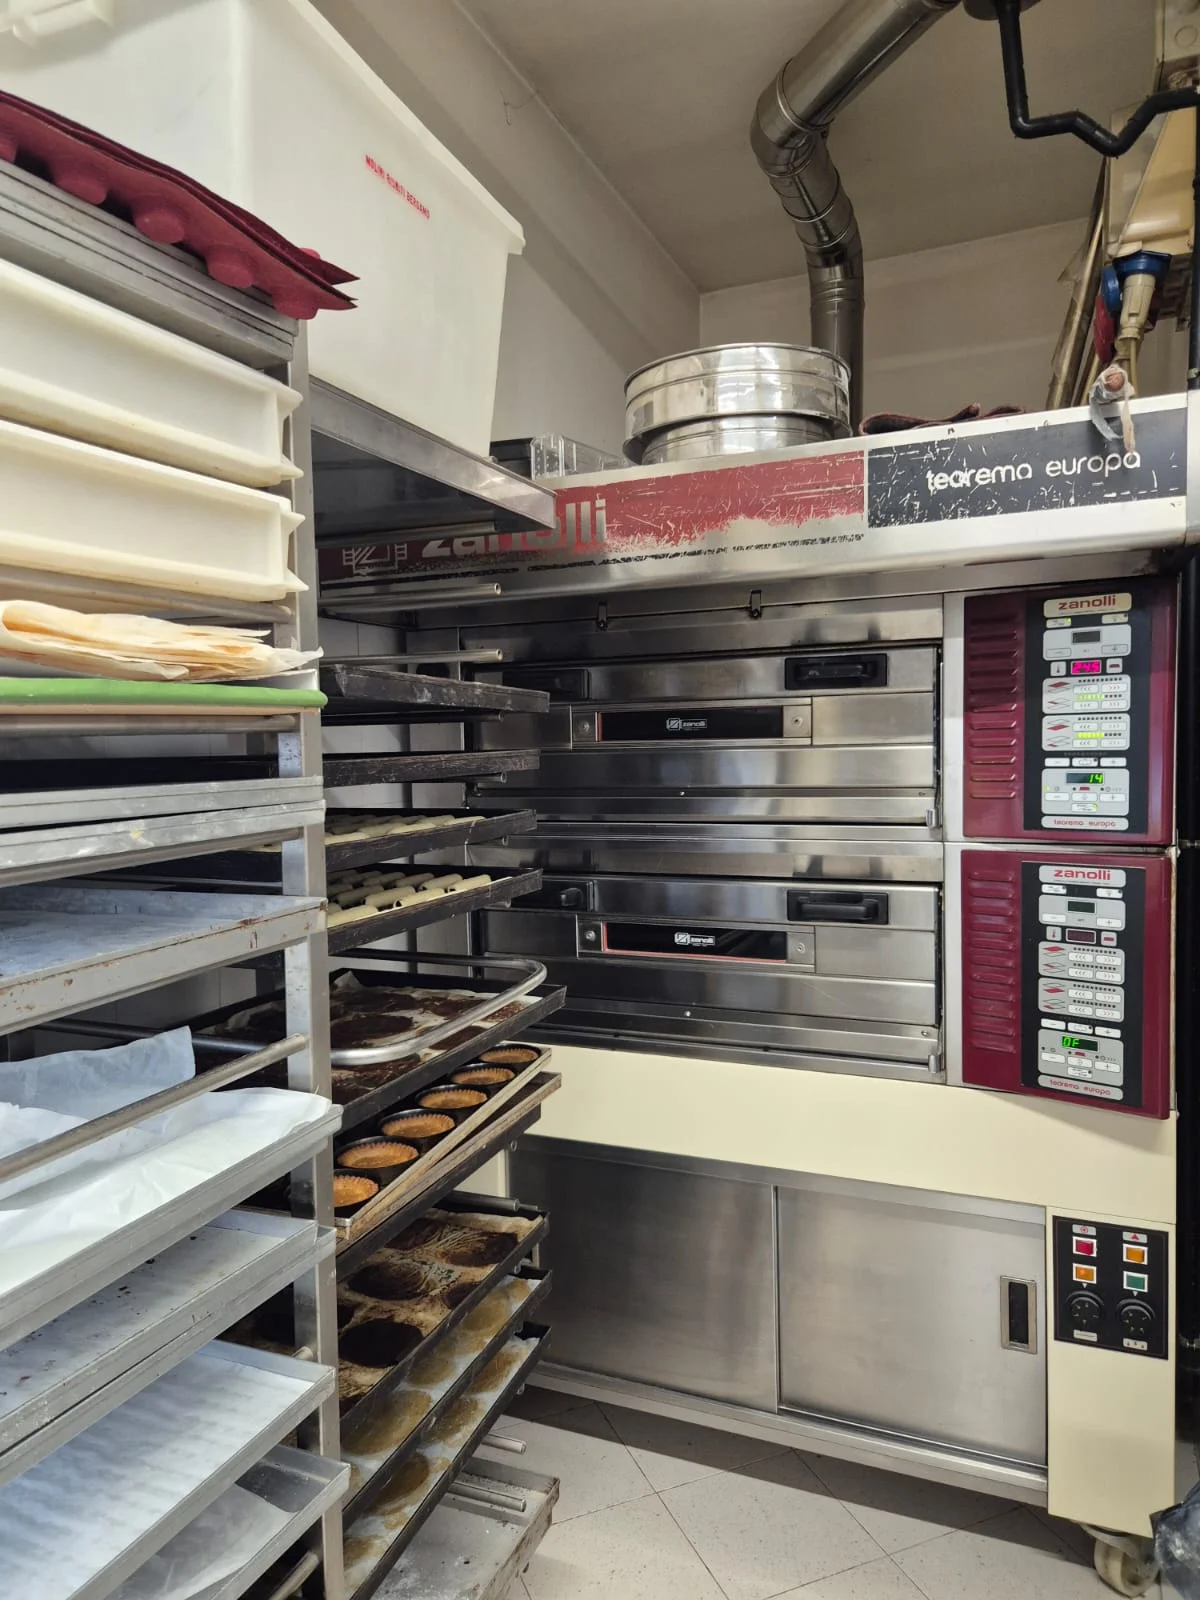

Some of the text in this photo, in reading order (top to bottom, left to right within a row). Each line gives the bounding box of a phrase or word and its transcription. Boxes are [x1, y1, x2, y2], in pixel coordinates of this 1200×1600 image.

[1045, 450, 1141, 478] europa
[1058, 594, 1116, 611] zanolli
[1089, 773, 1104, 784] 14
[1053, 869, 1111, 881] zanolli
[1083, 1086, 1112, 1096] europa
